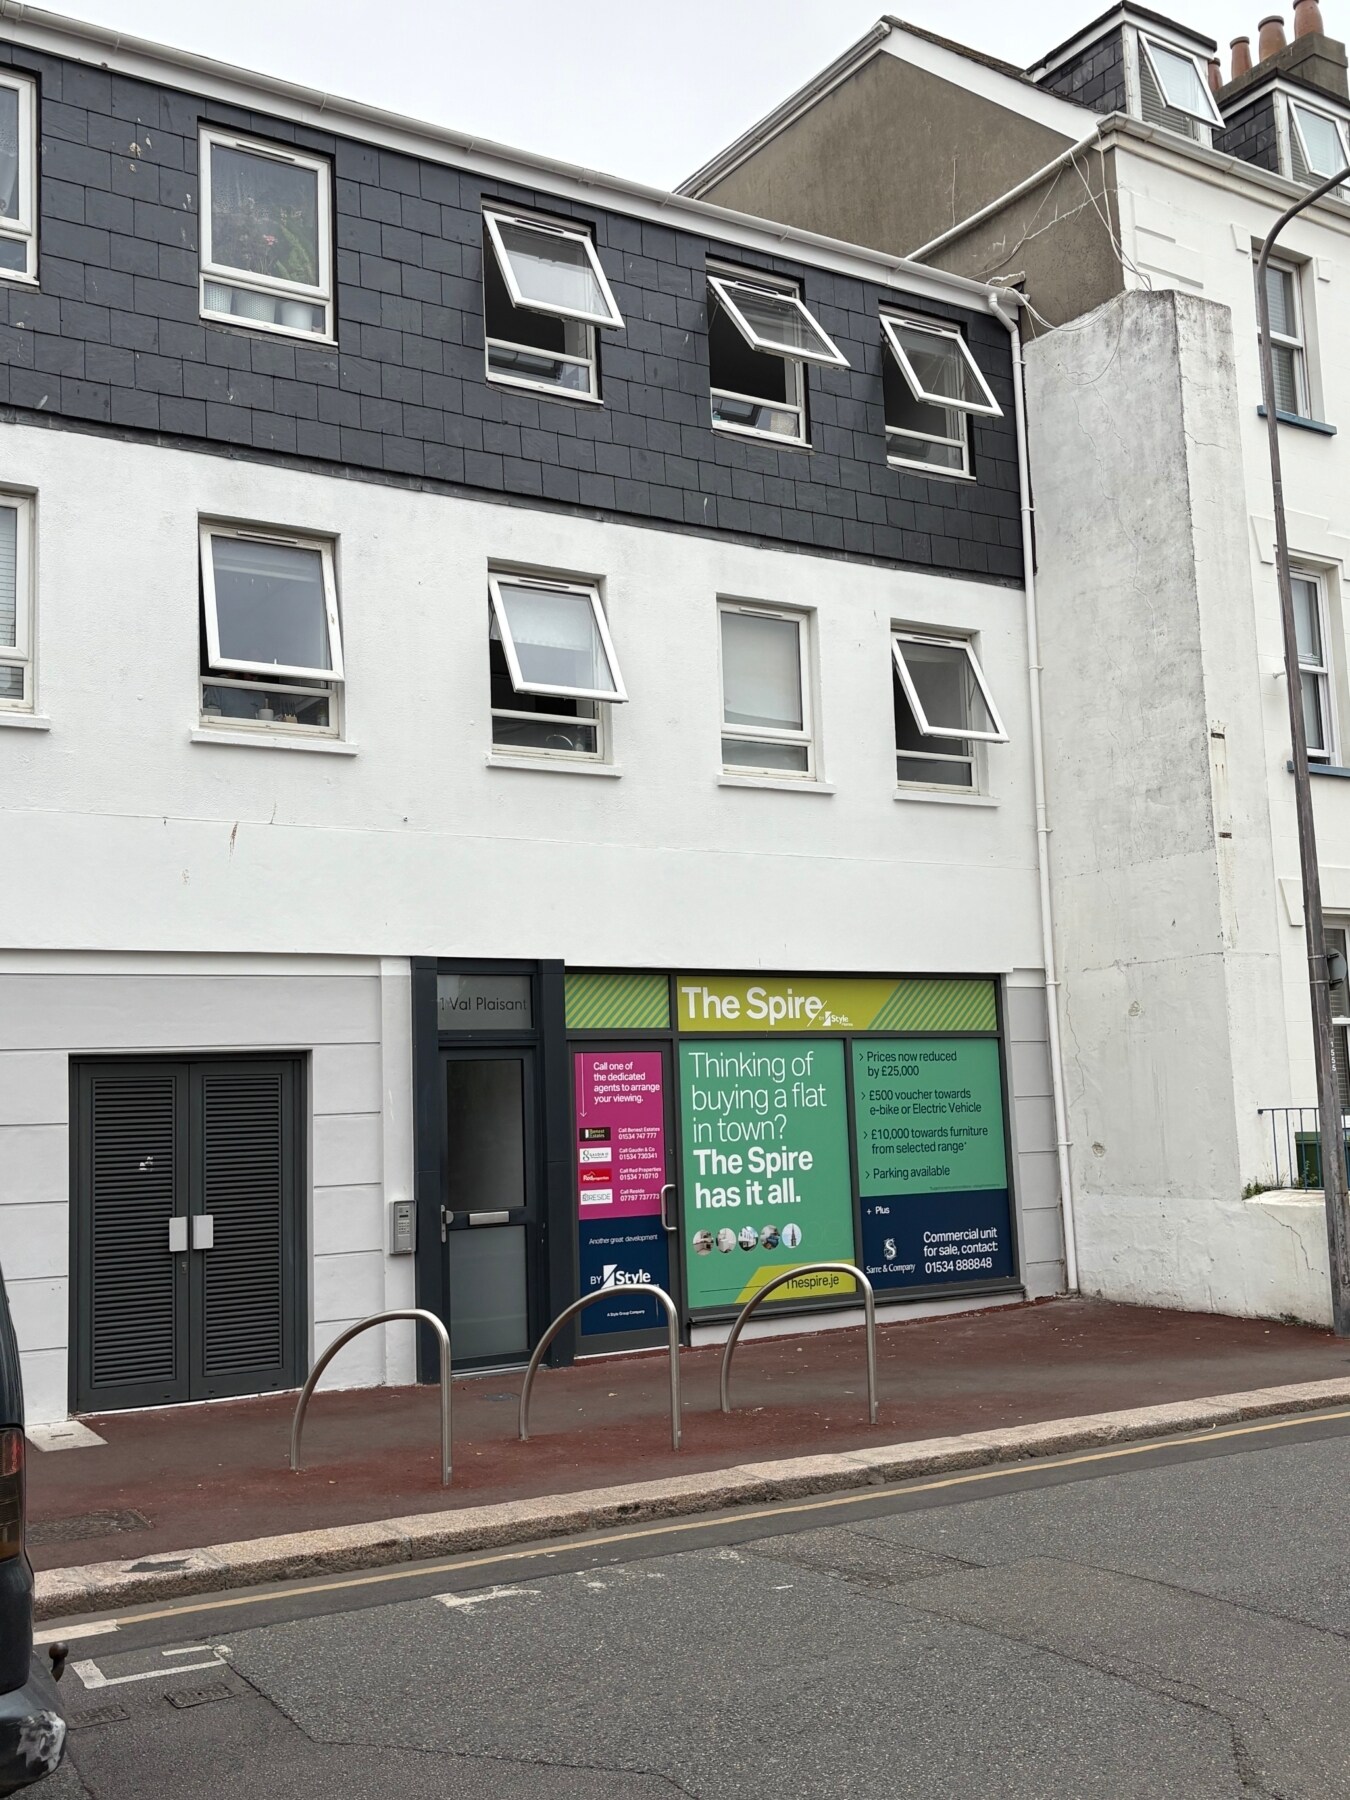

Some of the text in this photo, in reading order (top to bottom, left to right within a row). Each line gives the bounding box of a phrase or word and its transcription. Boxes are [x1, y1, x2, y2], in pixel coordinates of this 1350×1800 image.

[449, 996, 471, 1011] Val
[476, 996, 527, 1011] Plaisant
[681, 986, 823, 1026] The Spire
[831, 1014, 849, 1024] Style
[867, 1051, 957, 1062] Prices now reduced
[593, 1061, 633, 1071] Call one of
[688, 1051, 814, 1083] Thinking of
[867, 1065, 919, 1079] by £25,000
[594, 1072, 646, 1081] the dedicated
[594, 1084, 620, 1094] agents
[631, 1083, 660, 1093] arrange
[869, 1088, 972, 1101] £500 voucher towards
[594, 1094, 644, 1105] your viewing.
[692, 1082, 827, 1116] buying a flat
[869, 1102, 982, 1115] e-bike or Electric Vehicle
[693, 1113, 788, 1143] in town?
[871, 1126, 988, 1140] £10,000 towards furniture
[872, 1144, 894, 1154] from
[896, 1142, 936, 1153] selected
[693, 1145, 814, 1179] The Spire
[873, 1165, 951, 1180] Parking available
[695, 1177, 802, 1209] has it all.
[875, 1206, 890, 1215] Plus
[610, 1237, 624, 1245] great
[625, 1234, 658, 1242] development
[923, 1227, 998, 1243] Commercial unit
[923, 1241, 999, 1257] for sale, contact:
[866, 1263, 916, 1274] Sarre & Company
[924, 1257, 993, 1274] 01534 888848
[590, 1269, 651, 1285] BY Style
